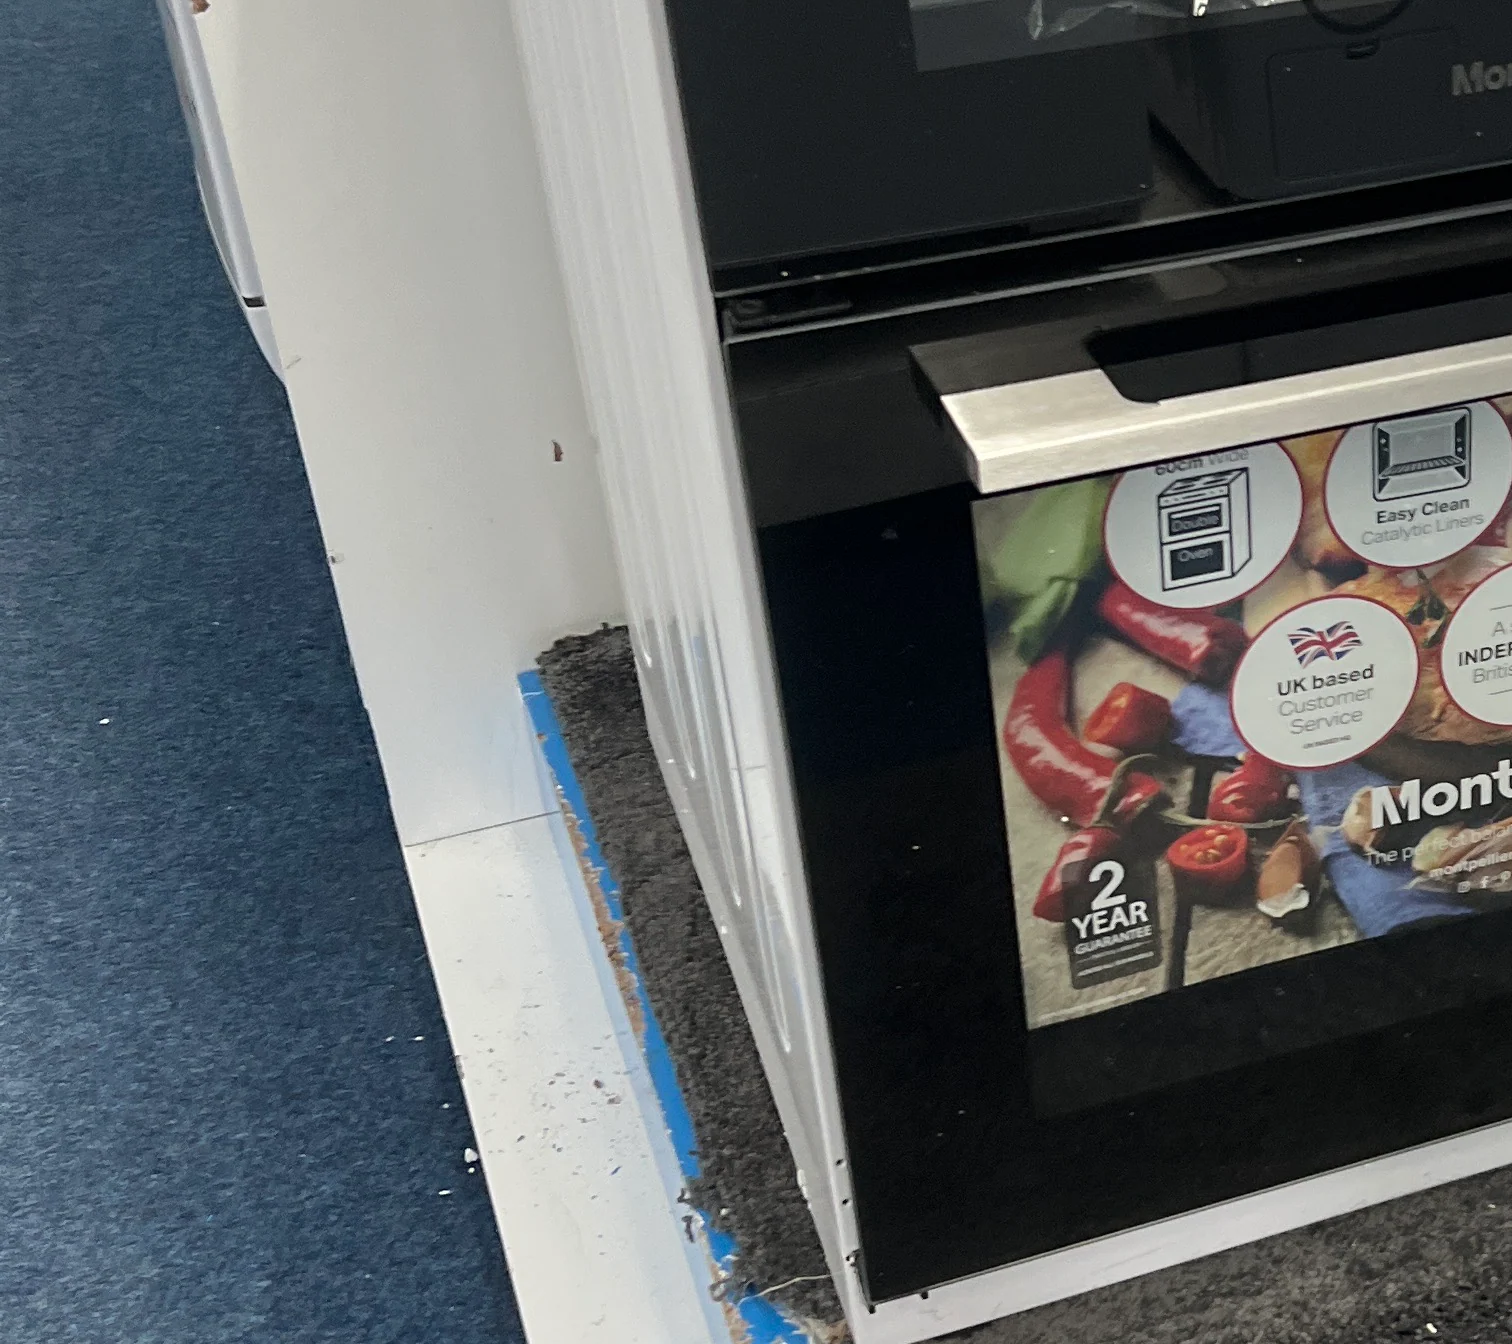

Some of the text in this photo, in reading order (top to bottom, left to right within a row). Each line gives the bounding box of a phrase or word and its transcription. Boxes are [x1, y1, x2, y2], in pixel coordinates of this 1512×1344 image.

[1376, 498, 1470, 525] Easy Clean
[1361, 512, 1485, 546] Catalytic Liners
[1491, 620, 1506, 638] A
[1277, 663, 1375, 696] UK based
[1278, 687, 1375, 717] Customer
[1289, 709, 1364, 735] Service
[1367, 847, 1399, 866] The
[1088, 860, 1127, 911] 2
[1071, 900, 1150, 939] YEAR
